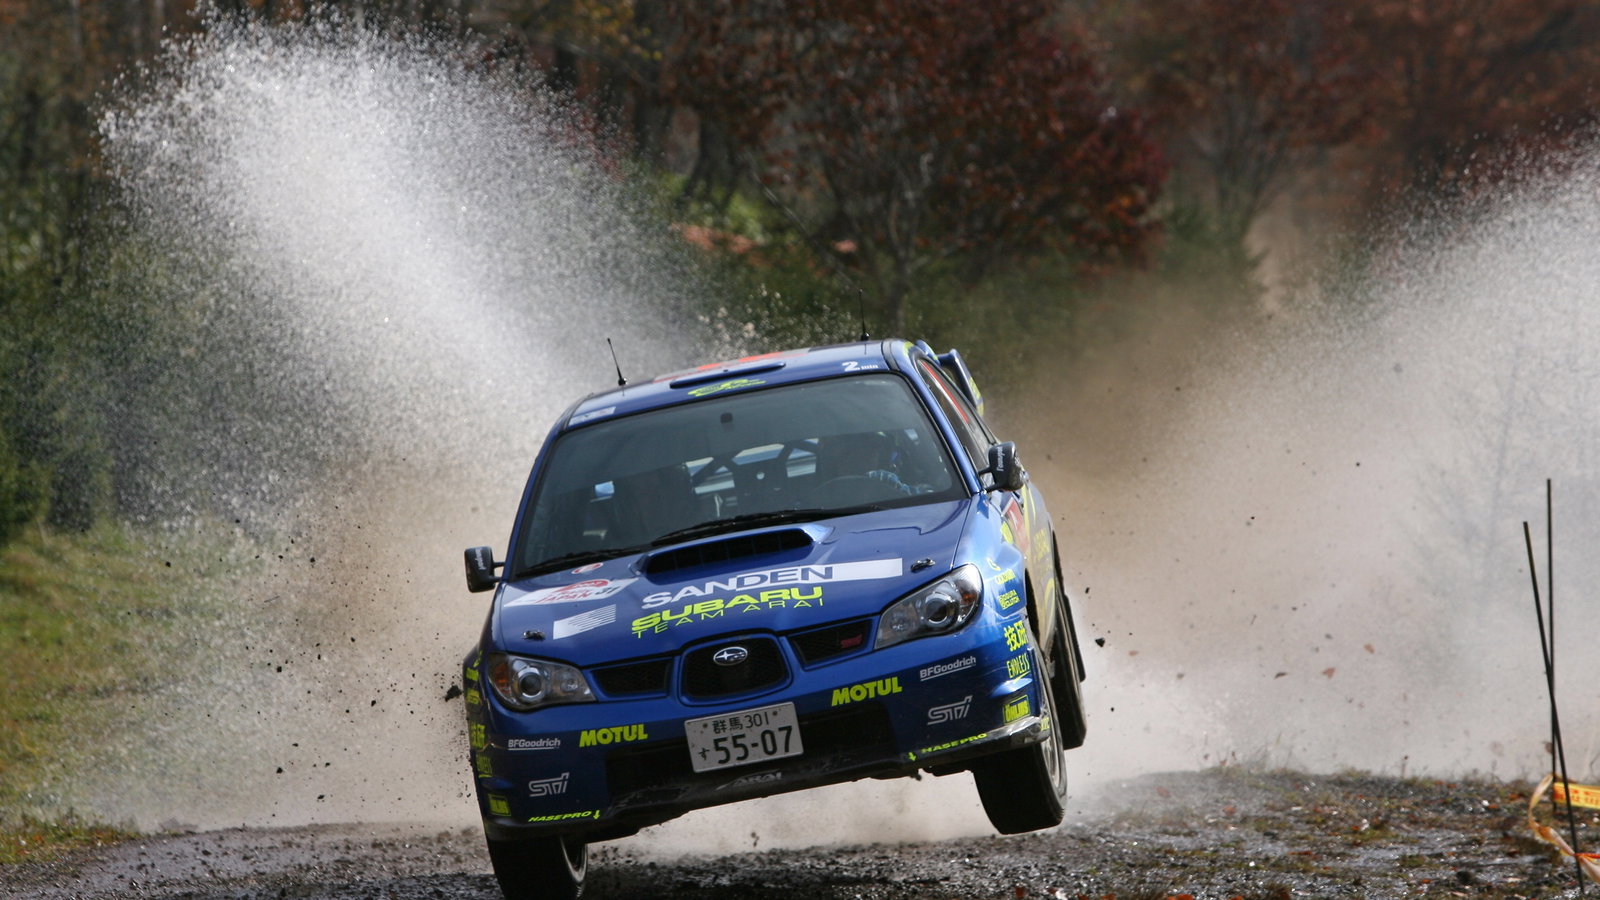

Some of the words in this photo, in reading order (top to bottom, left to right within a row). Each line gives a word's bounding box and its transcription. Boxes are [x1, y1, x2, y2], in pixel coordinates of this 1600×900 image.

[641, 566, 833, 610] SANDEN
[631, 586, 823, 632] SUBARU
[631, 611, 724, 639] TEAM
[743, 597, 824, 613] ARAI
[919, 655, 977, 680] BFGoodrich
[831, 676, 903, 707] MOTUL
[508, 737, 561, 749] BFGoodrich
[579, 724, 649, 748] MOTUL
[698, 747, 710, 760] す
[713, 725, 793, 764] 55-07
[528, 810, 592, 823] HASEPRO
